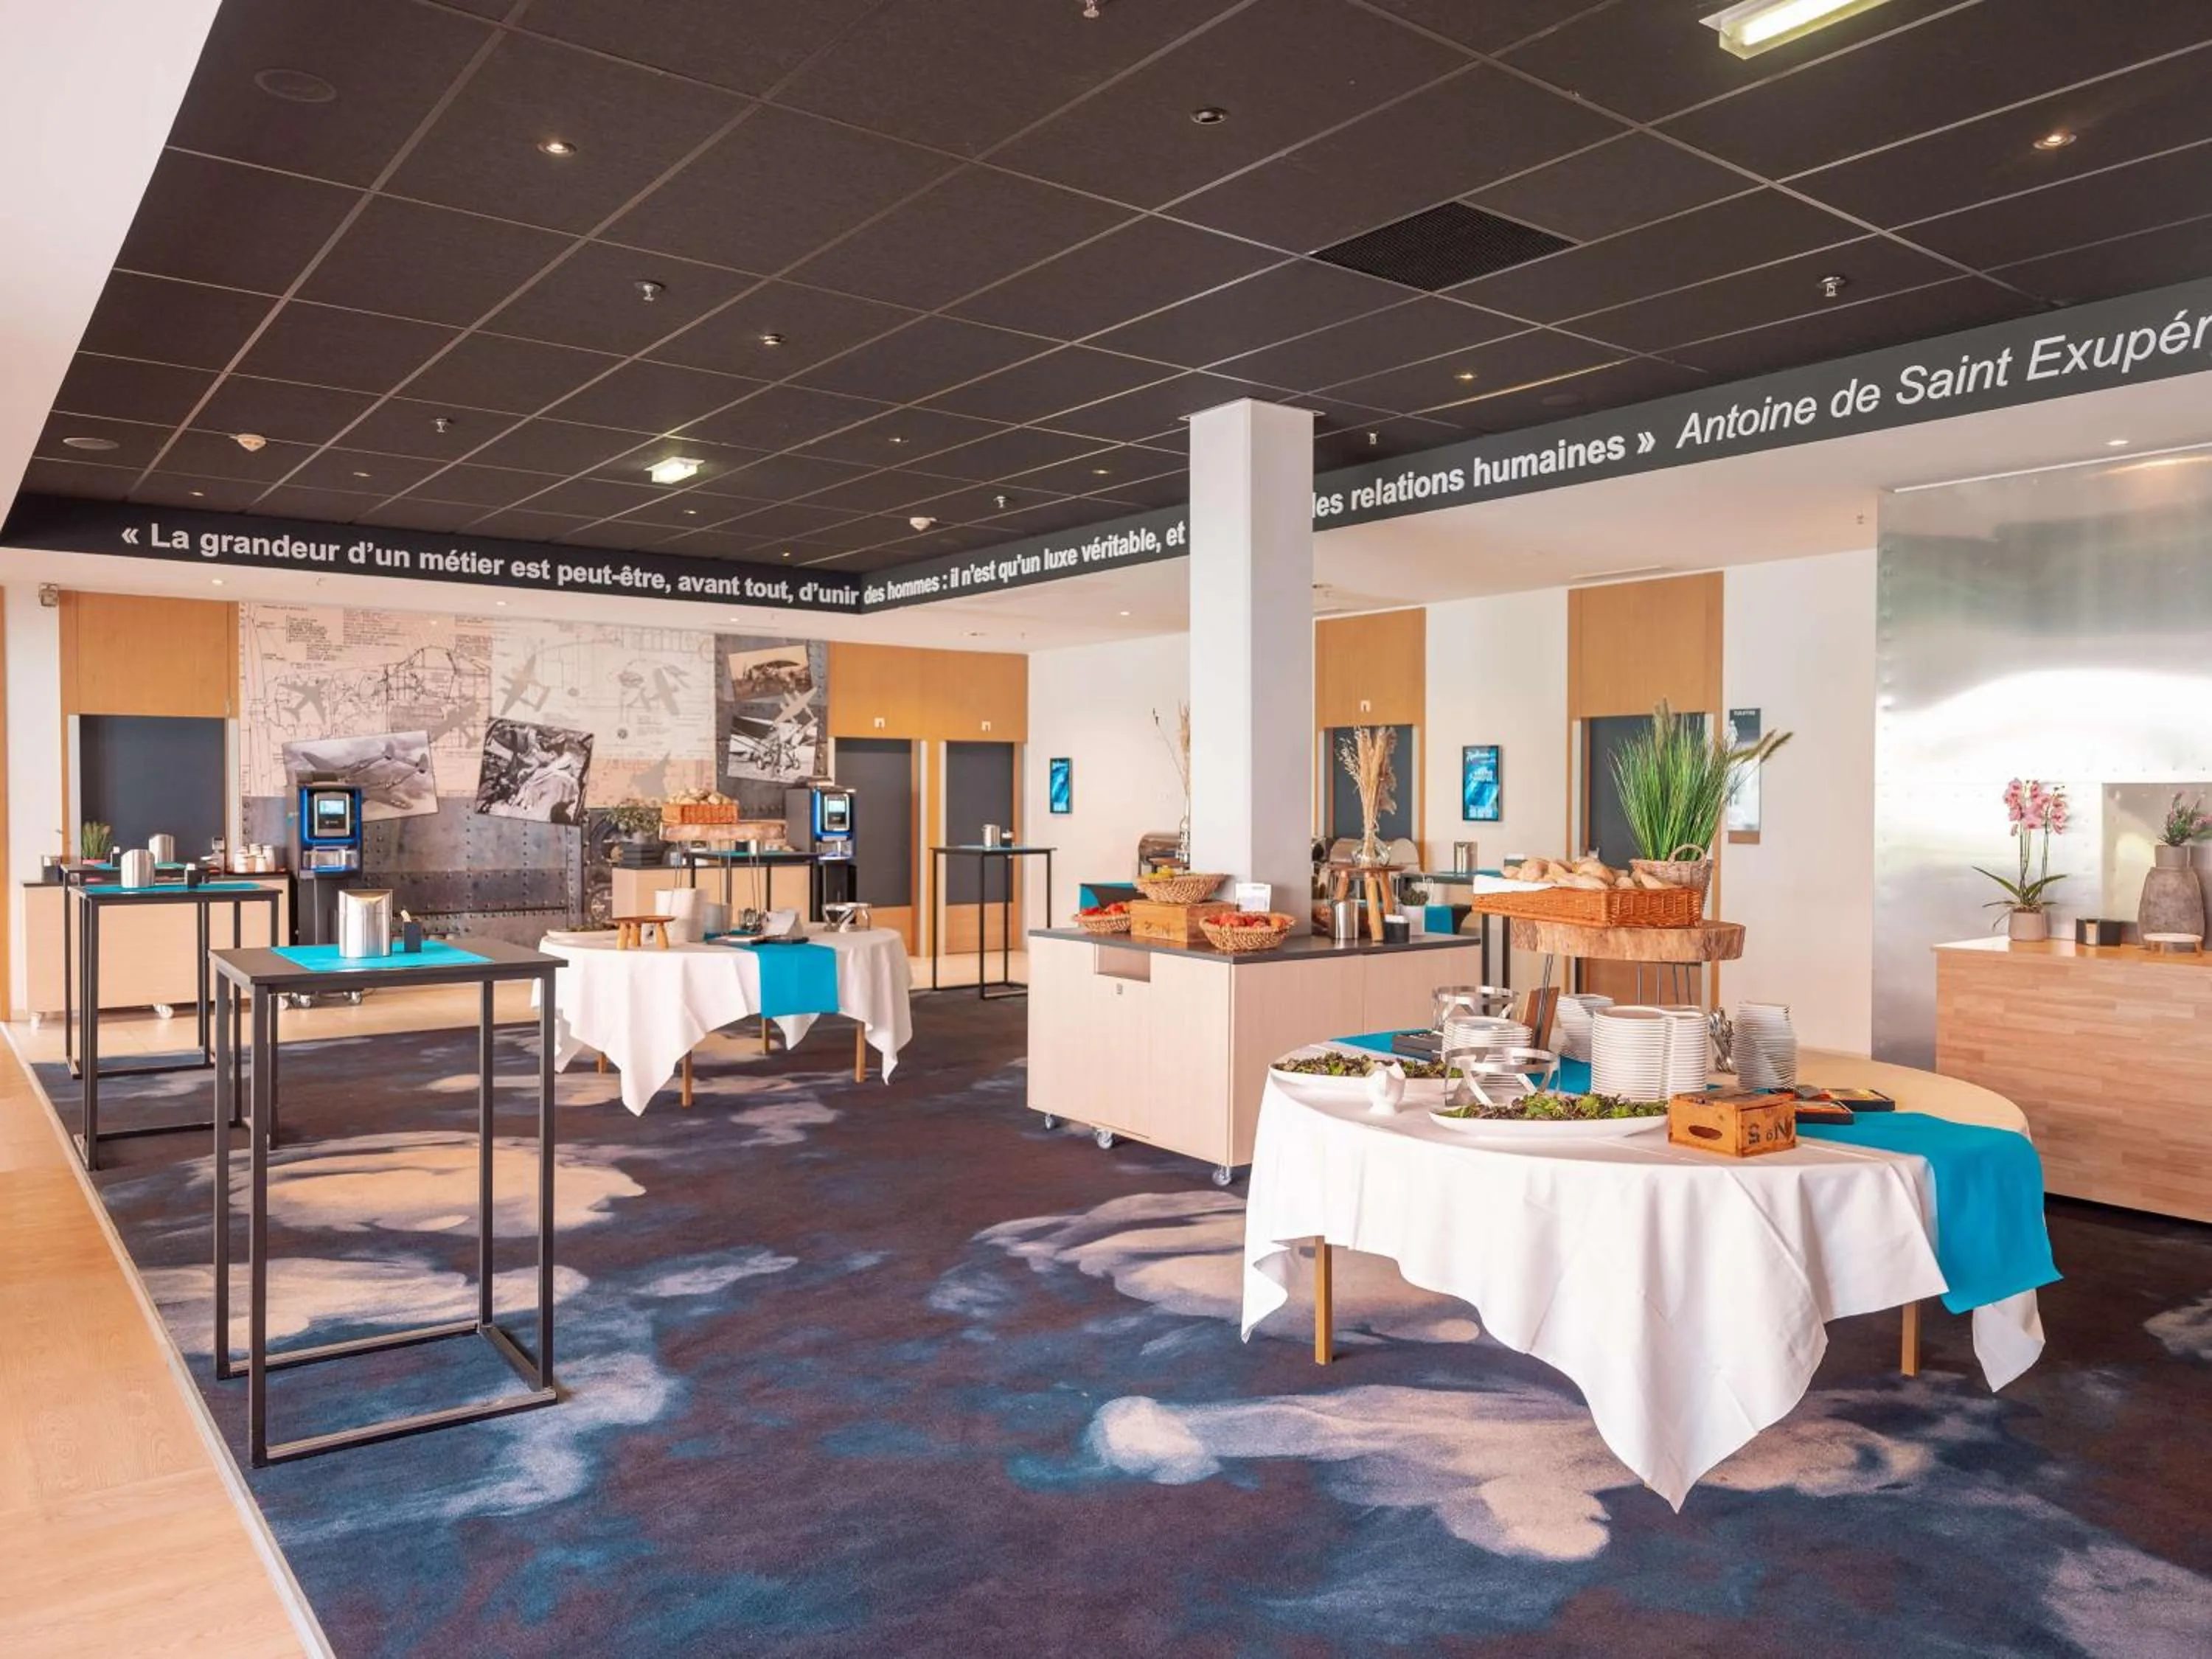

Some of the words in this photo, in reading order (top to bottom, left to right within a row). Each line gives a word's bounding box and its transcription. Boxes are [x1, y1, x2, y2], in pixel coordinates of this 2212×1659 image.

[1312, 492, 1343, 518] es
[1351, 468, 1465, 510] relations
[1473, 436, 1626, 487] humaines
[1675, 396, 1818, 449] Antoine
[1830, 378, 1881, 418] de
[1896, 347, 2013, 405] Saint
[2026, 309, 2212, 381] Exupér
[151, 523, 189, 549] La
[200, 535, 341, 561] grandeur
[420, 549, 505, 575] métier
[511, 559, 551, 580] est
[557, 564, 671, 594] peut-être,
[678, 576, 740, 596] avant
[744, 577, 794, 604] tout,
[863, 585, 886, 605] des
[887, 576, 940, 600] hommes
[950, 566, 960, 588] il
[1043, 547, 1079, 571] luxe
[1080, 526, 1162, 563] véritable,
[1166, 520, 1186, 547] et
